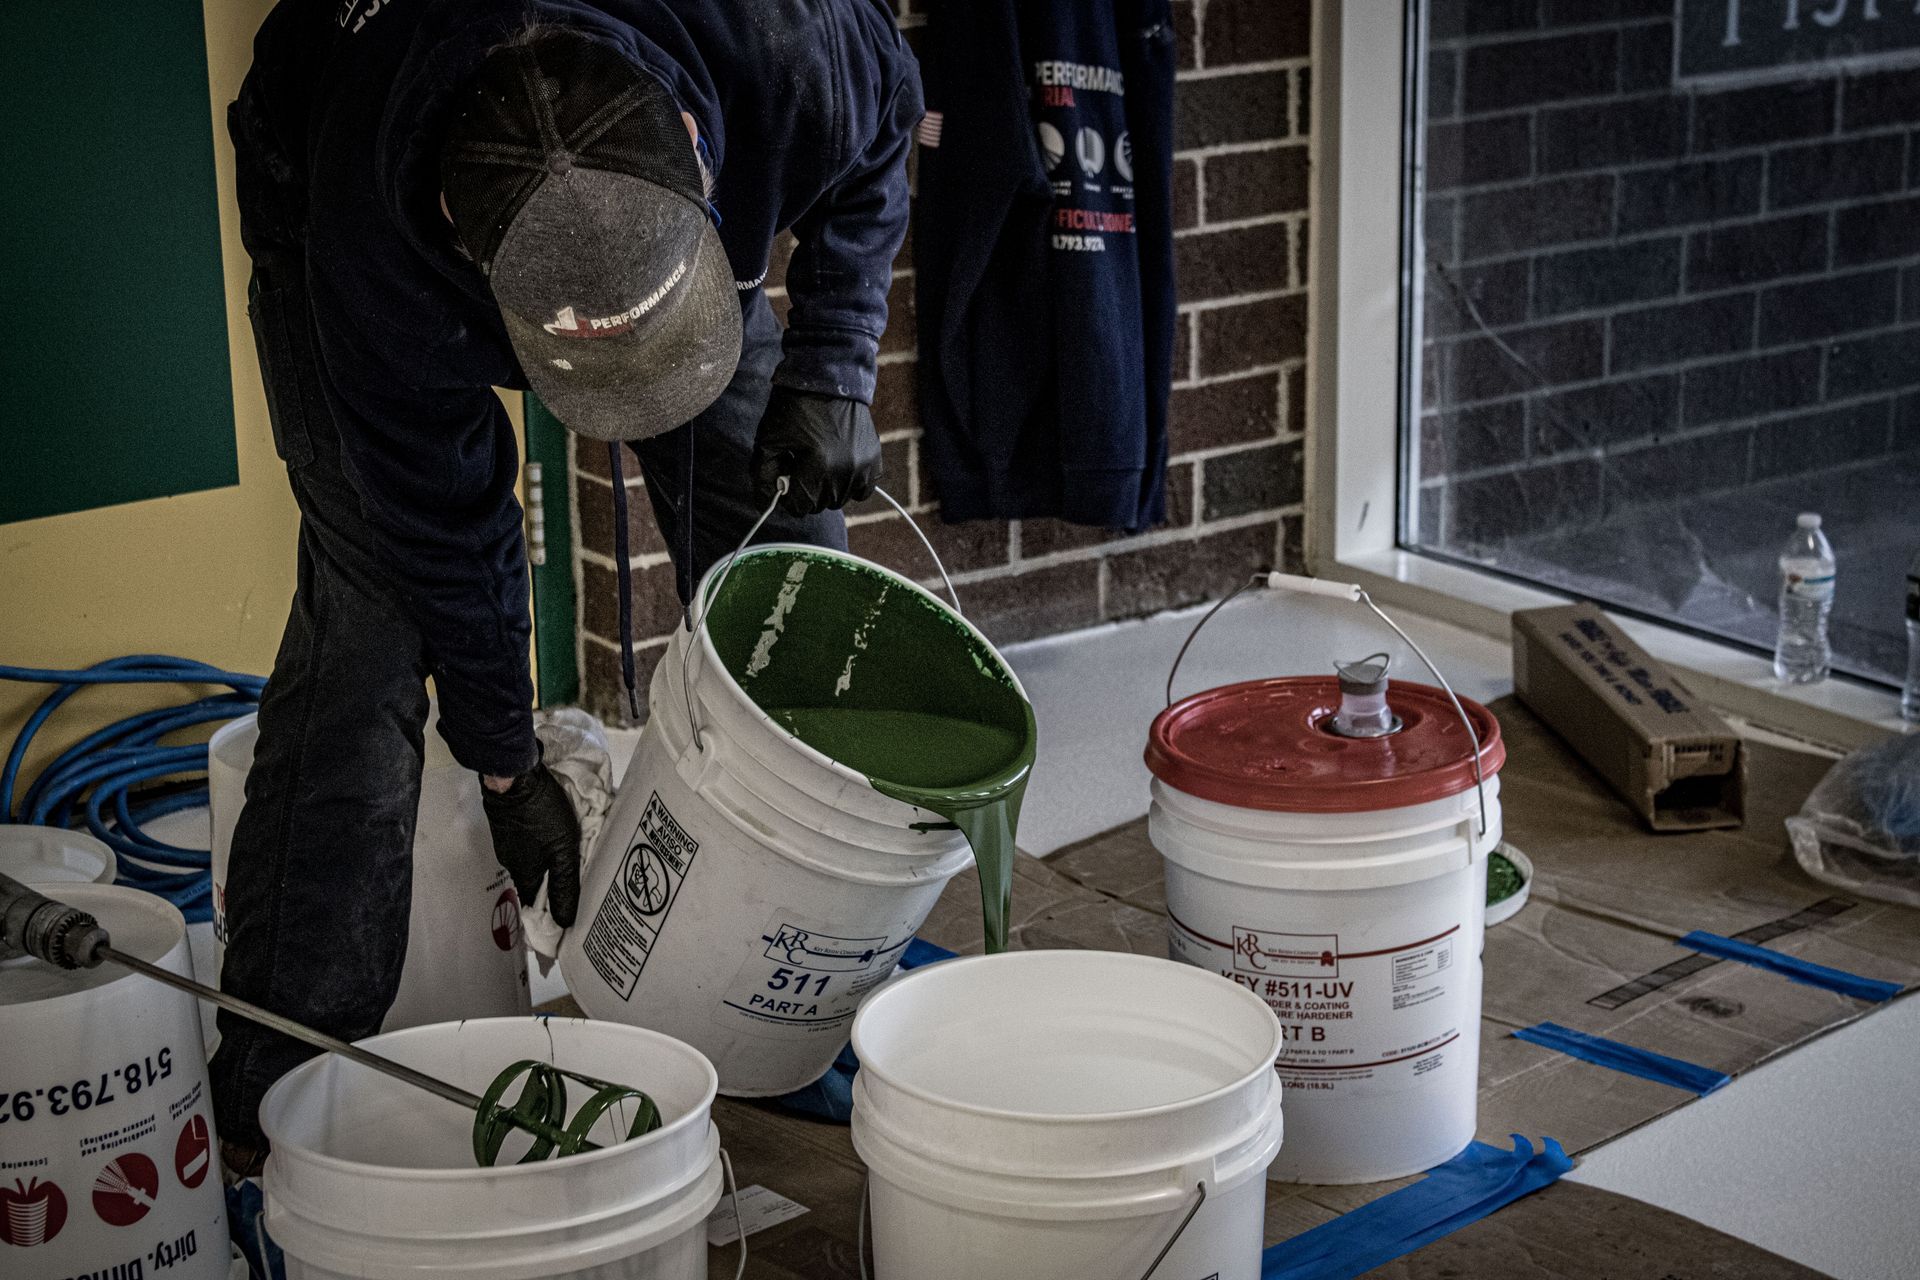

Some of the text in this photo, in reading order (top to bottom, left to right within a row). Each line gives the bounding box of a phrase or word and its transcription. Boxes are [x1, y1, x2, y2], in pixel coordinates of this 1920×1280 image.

[589, 261, 687, 330] PERFORMANCE
[657, 805, 696, 854] WARNING
[657, 825, 682, 856] AVISO
[767, 967, 831, 997] 511
[1265, 980, 1354, 999] #511-UV
[749, 993, 818, 1016] PART A
[1295, 1002, 1302, 1010] &
[1304, 1001, 1350, 1011] COATING
[1296, 1011, 1354, 1020] HARDENER
[1311, 1026, 1326, 1042] B
[1307, 1082, 1334, 1090] (18.9L)
[79, 1113, 155, 1148] pressure washing]
[81, 1143, 97, 1157] and
[148, 1229, 198, 1271] Dirty.
